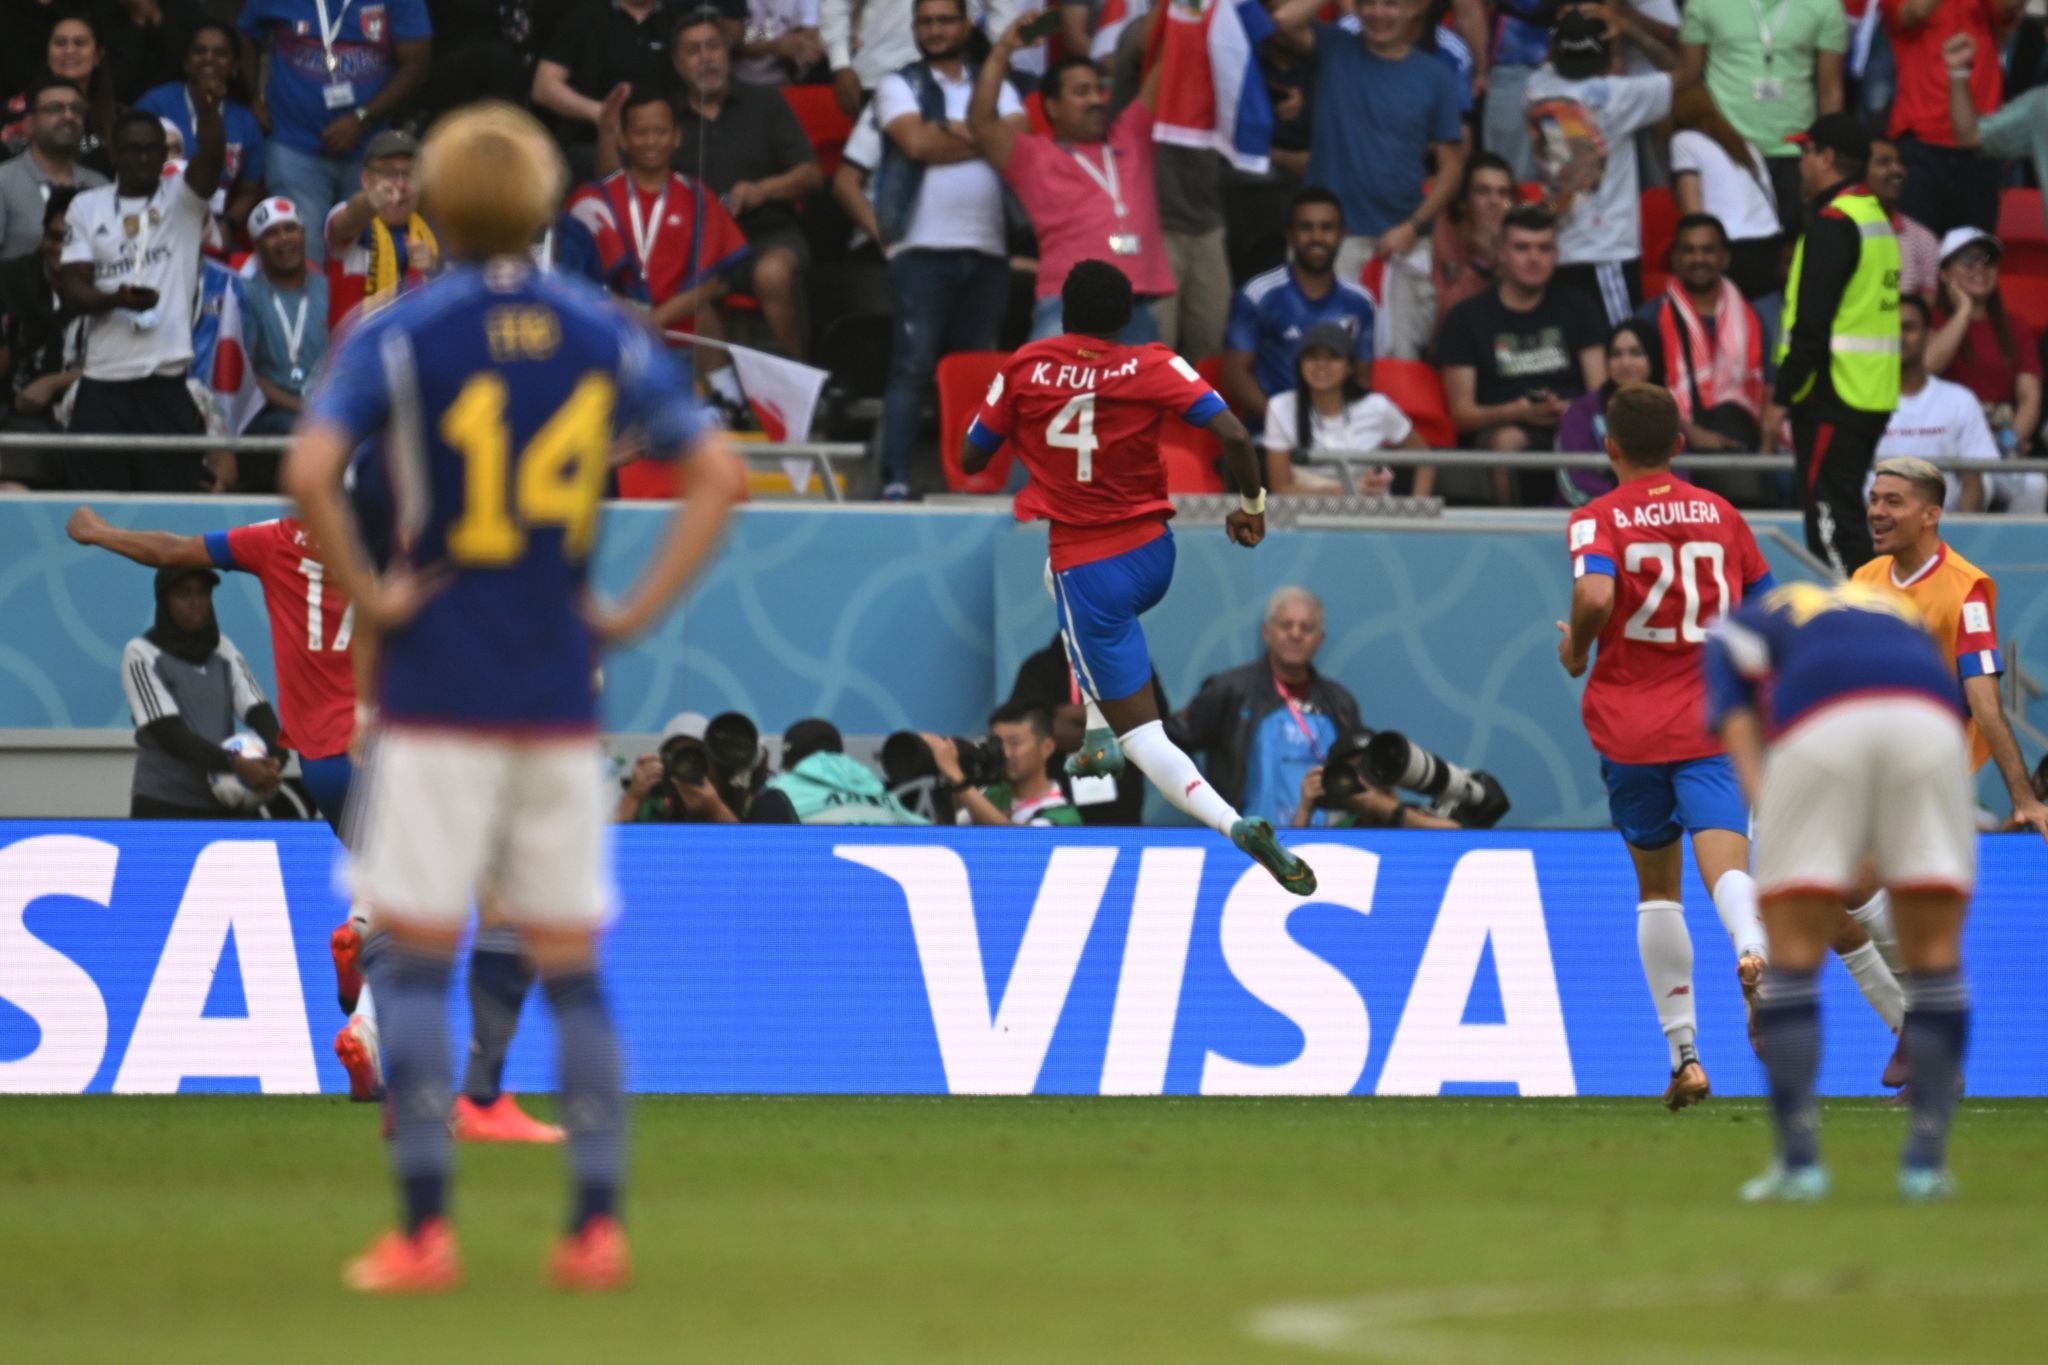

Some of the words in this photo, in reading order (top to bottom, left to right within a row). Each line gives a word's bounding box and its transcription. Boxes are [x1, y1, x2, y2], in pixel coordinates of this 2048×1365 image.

[1031, 361, 1051, 386] K.
[1055, 358, 1138, 389] FULR
[441, 370, 615, 565] 14
[1046, 392, 1099, 482] 4
[1613, 507, 1632, 528] B.
[1634, 500, 1720, 527] AGUILERA
[1624, 541, 1730, 643] 20
[833, 843, 1577, 1096] VISA
